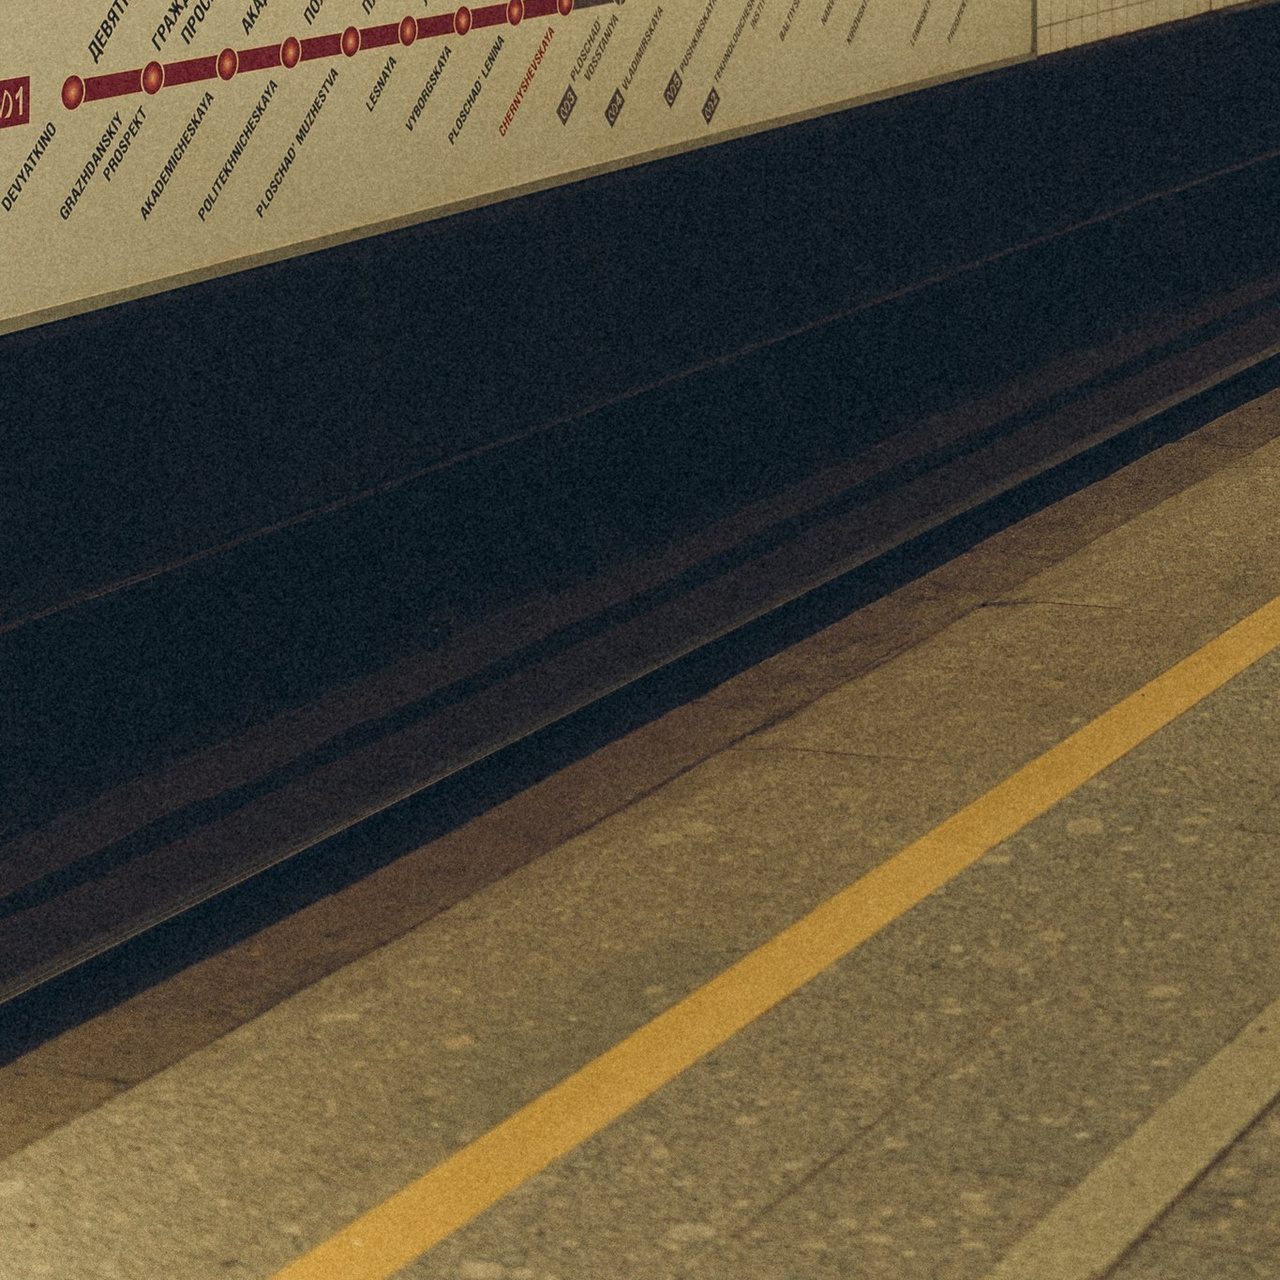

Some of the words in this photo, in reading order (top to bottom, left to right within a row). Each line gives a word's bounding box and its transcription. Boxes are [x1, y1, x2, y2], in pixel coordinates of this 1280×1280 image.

[365, 56, 397, 112] LESNAYA
[405, 45, 452, 132] VYBORGSKAYA
[482, 35, 505, 78] LENINA
[499, 26, 555, 137] CHERNYSHEVSKAYA
[584, 14, 619, 81] VOSSTANIYA
[622, 5, 664, 90] VLADIMIRSKAYA
[102, 105, 147, 181] PROSPEKT
[295, 68, 339, 146] MUZHESTVA
[1, 122, 57, 212] DEVYATKINO
[59, 111, 123, 221] GRAZHDANSKIY
[140, 92, 214, 221] AKADEMICHESKAYA
[198, 80, 278, 222] POLITEKHNICHESKAYA
